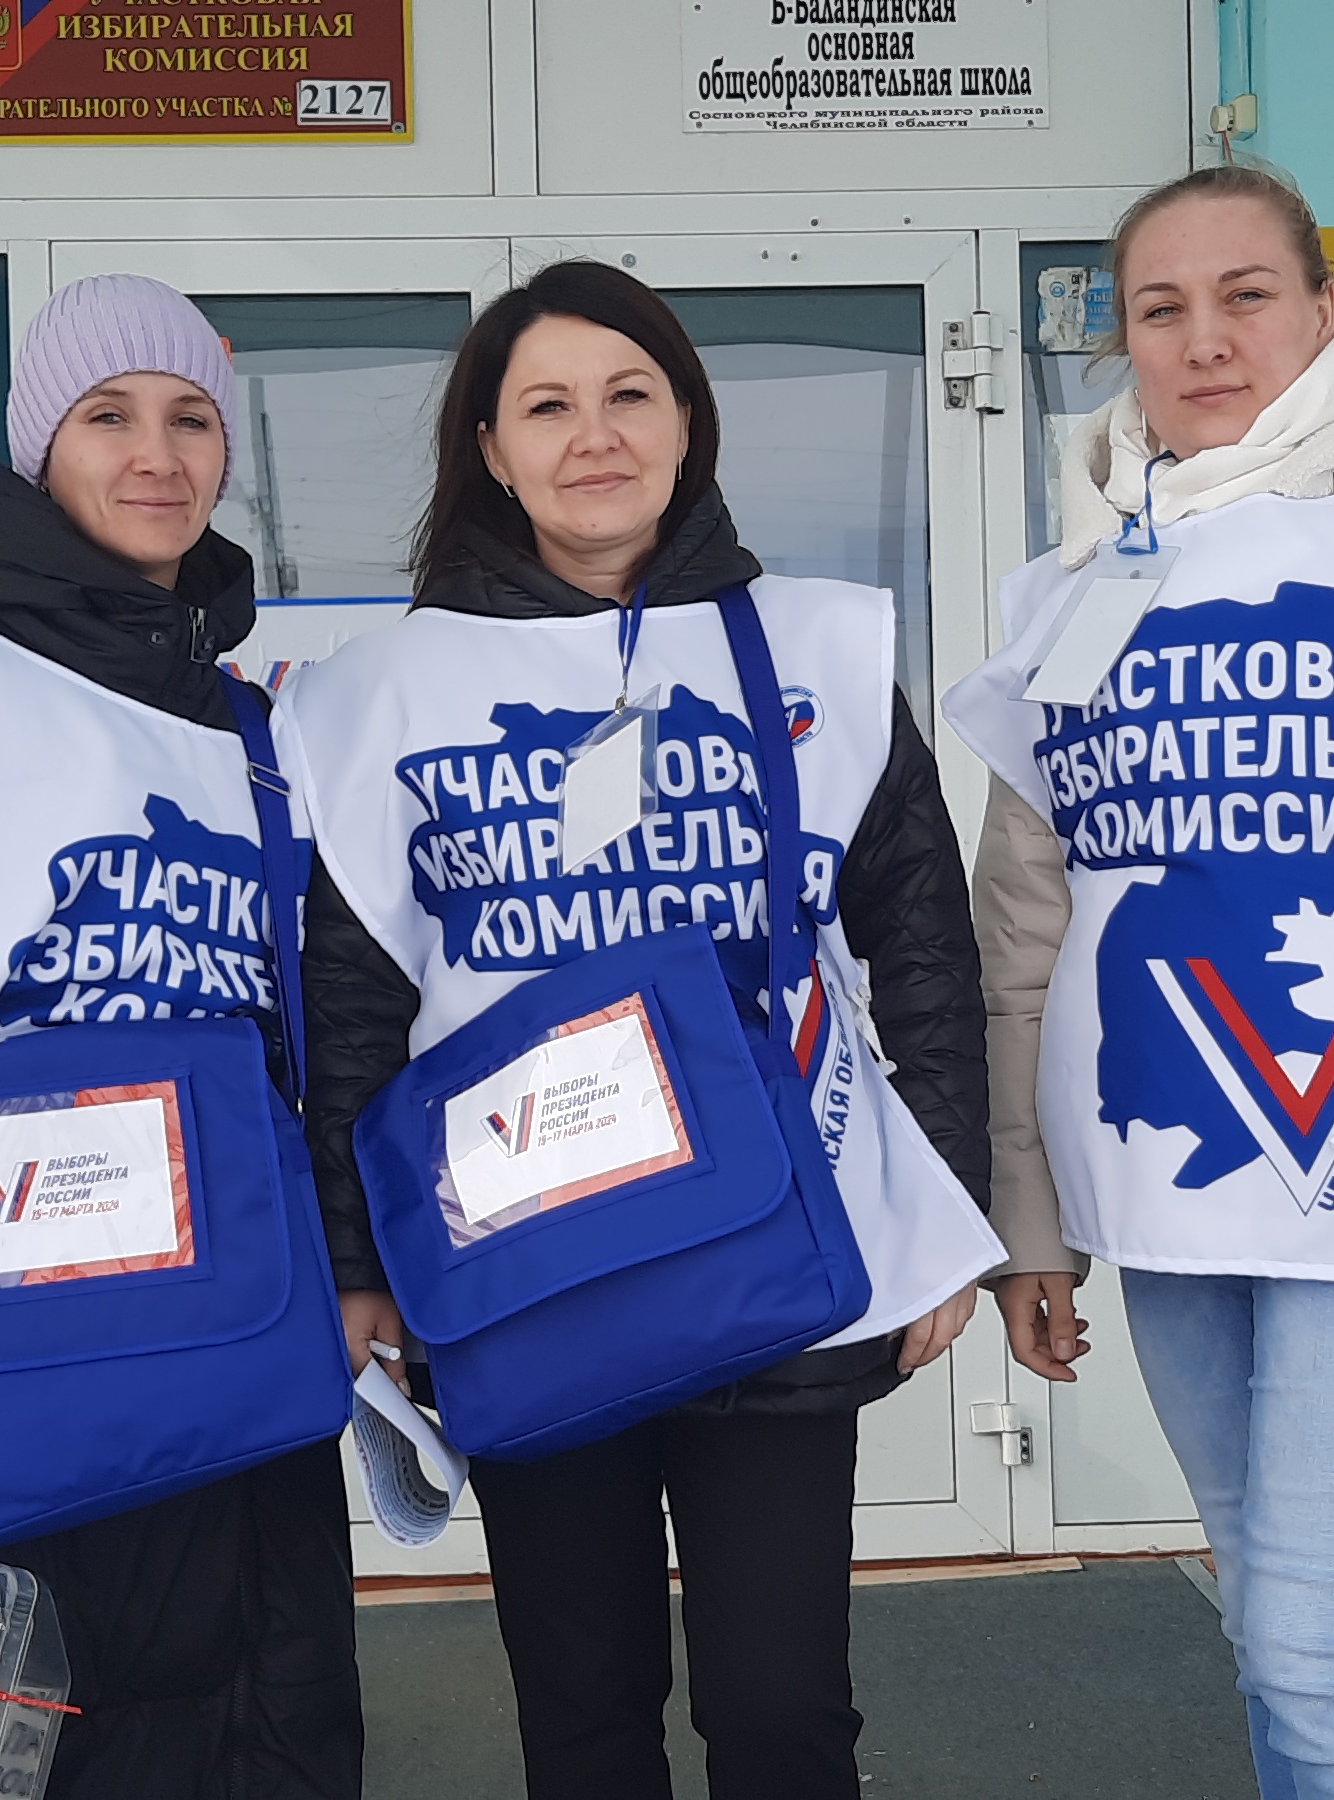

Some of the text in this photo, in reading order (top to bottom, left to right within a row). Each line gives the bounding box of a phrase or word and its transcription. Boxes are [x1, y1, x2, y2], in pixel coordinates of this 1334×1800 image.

[56, 14, 354, 39] ИЗБИРАТЕЛЬНАЯ
[807, 32, 915, 61] основная
[103, 47, 310, 72] КОМИССИЯ
[698, 56, 1032, 109] общеобразовательная школа
[155, 97, 265, 118] УЧАСТКА
[301, 84, 387, 116] 2127
[688, 105, 1044, 120] Сосновского муниципального района
[765, 117, 969, 130] Челябинской области
[543, 1073, 599, 1100] ВЫБОРЫ
[541, 1083, 620, 1118] ПРЕЗИДЕНТА
[539, 1107, 589, 1134] РОССИИ
[563, 1120, 594, 1138] МАРТА
[46, 1152, 109, 1172] ВЫБОРЫ
[41, 1165, 129, 1189] ПРЕЗИДЕНТА
[35, 1187, 93, 1206] РОССИИ
[60, 1203, 94, 1218] МАРТА
